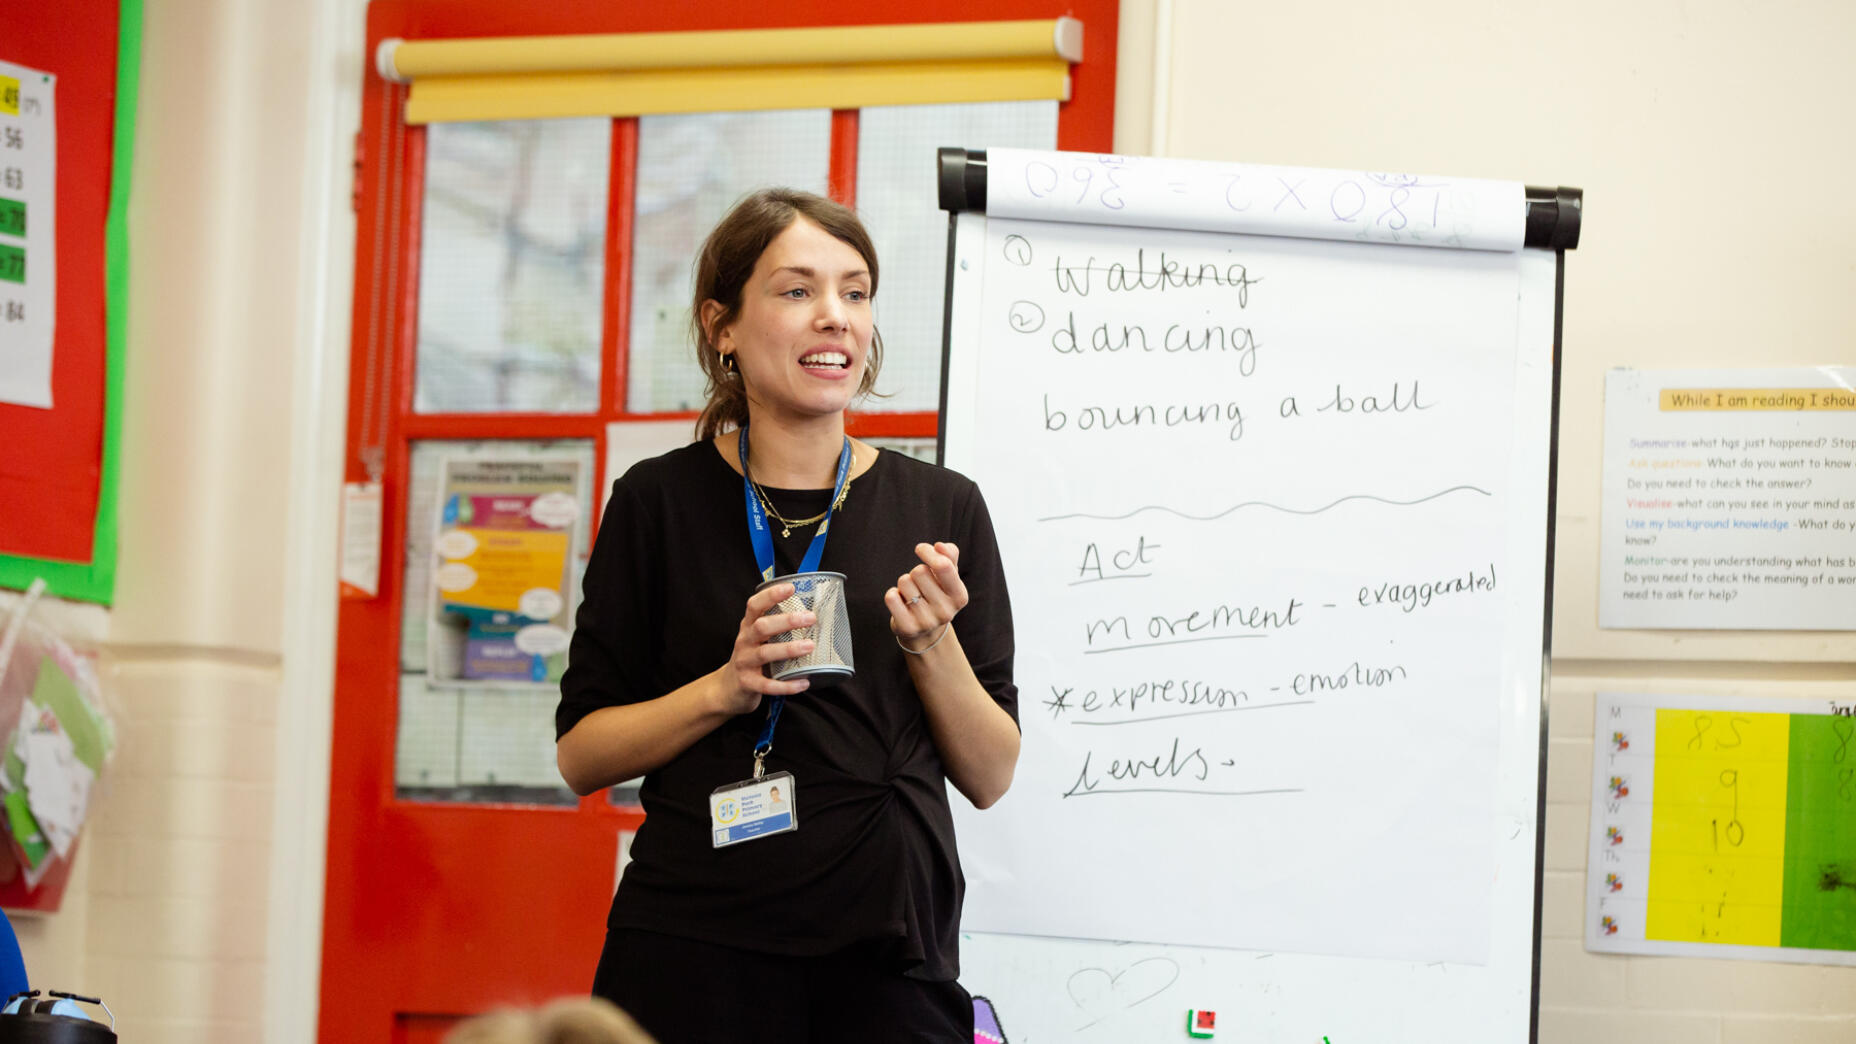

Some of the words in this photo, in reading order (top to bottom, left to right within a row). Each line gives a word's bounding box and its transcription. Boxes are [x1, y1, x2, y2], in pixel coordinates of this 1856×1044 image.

[5, 126, 23, 149] 56
[1052, 311, 1263, 377] dancing
[1671, 393, 1711, 407] While
[1716, 393, 1723, 407] I
[1728, 396, 1748, 407] am
[1752, 393, 1805, 411] reading
[1811, 393, 1818, 407] I
[1044, 394, 1246, 441] bouncing
[1280, 395, 1303, 419] a
[1316, 380, 1436, 415] ball
[1744, 438, 1765, 451] just
[1769, 437, 1827, 451] happened?
[1707, 457, 1736, 468] What
[1740, 458, 1753, 468] do
[1757, 460, 1776, 471] you
[1780, 458, 1804, 469] want
[1810, 459, 1820, 469] to
[1824, 457, 1851, 469] know
[1627, 478, 1641, 489] Do
[1645, 480, 1663, 492] you
[1666, 477, 1692, 489] need
[1696, 478, 1706, 489] to
[1710, 477, 1741, 489] check
[1746, 477, 1764, 489] the
[1767, 478, 1812, 489] answer?
[1706, 500, 1725, 509] can
[1728, 500, 1747, 512] you
[1751, 500, 1768, 509] see
[1773, 499, 1783, 509] in
[1785, 500, 1809, 512] your
[1813, 498, 1840, 509] mind
[1843, 500, 1855, 509] as
[1625, 518, 1646, 529] Use
[1649, 520, 1664, 532] my
[1667, 518, 1729, 532] background
[1733, 518, 1789, 532] knowledge
[1832, 519, 1846, 530] do
[1625, 535, 1657, 546] know?
[1080, 536, 1160, 580] Act
[1692, 557, 1711, 568] you
[1713, 555, 1792, 570] understanding
[1795, 556, 1822, 568] what
[1826, 555, 1845, 568] has
[1624, 572, 1638, 584] Do
[1641, 575, 1659, 586] you
[1662, 572, 1688, 583] need
[1692, 573, 1703, 584] to
[1706, 572, 1738, 584] check
[1743, 573, 1761, 584] the
[1764, 575, 1809, 588] meaning
[1812, 572, 1824, 584] of
[1827, 576, 1835, 585] a
[1623, 589, 1649, 600] need
[1652, 589, 1662, 600] to
[1666, 588, 1684, 600] ask
[1688, 588, 1704, 600] for
[1708, 589, 1738, 603] help?
